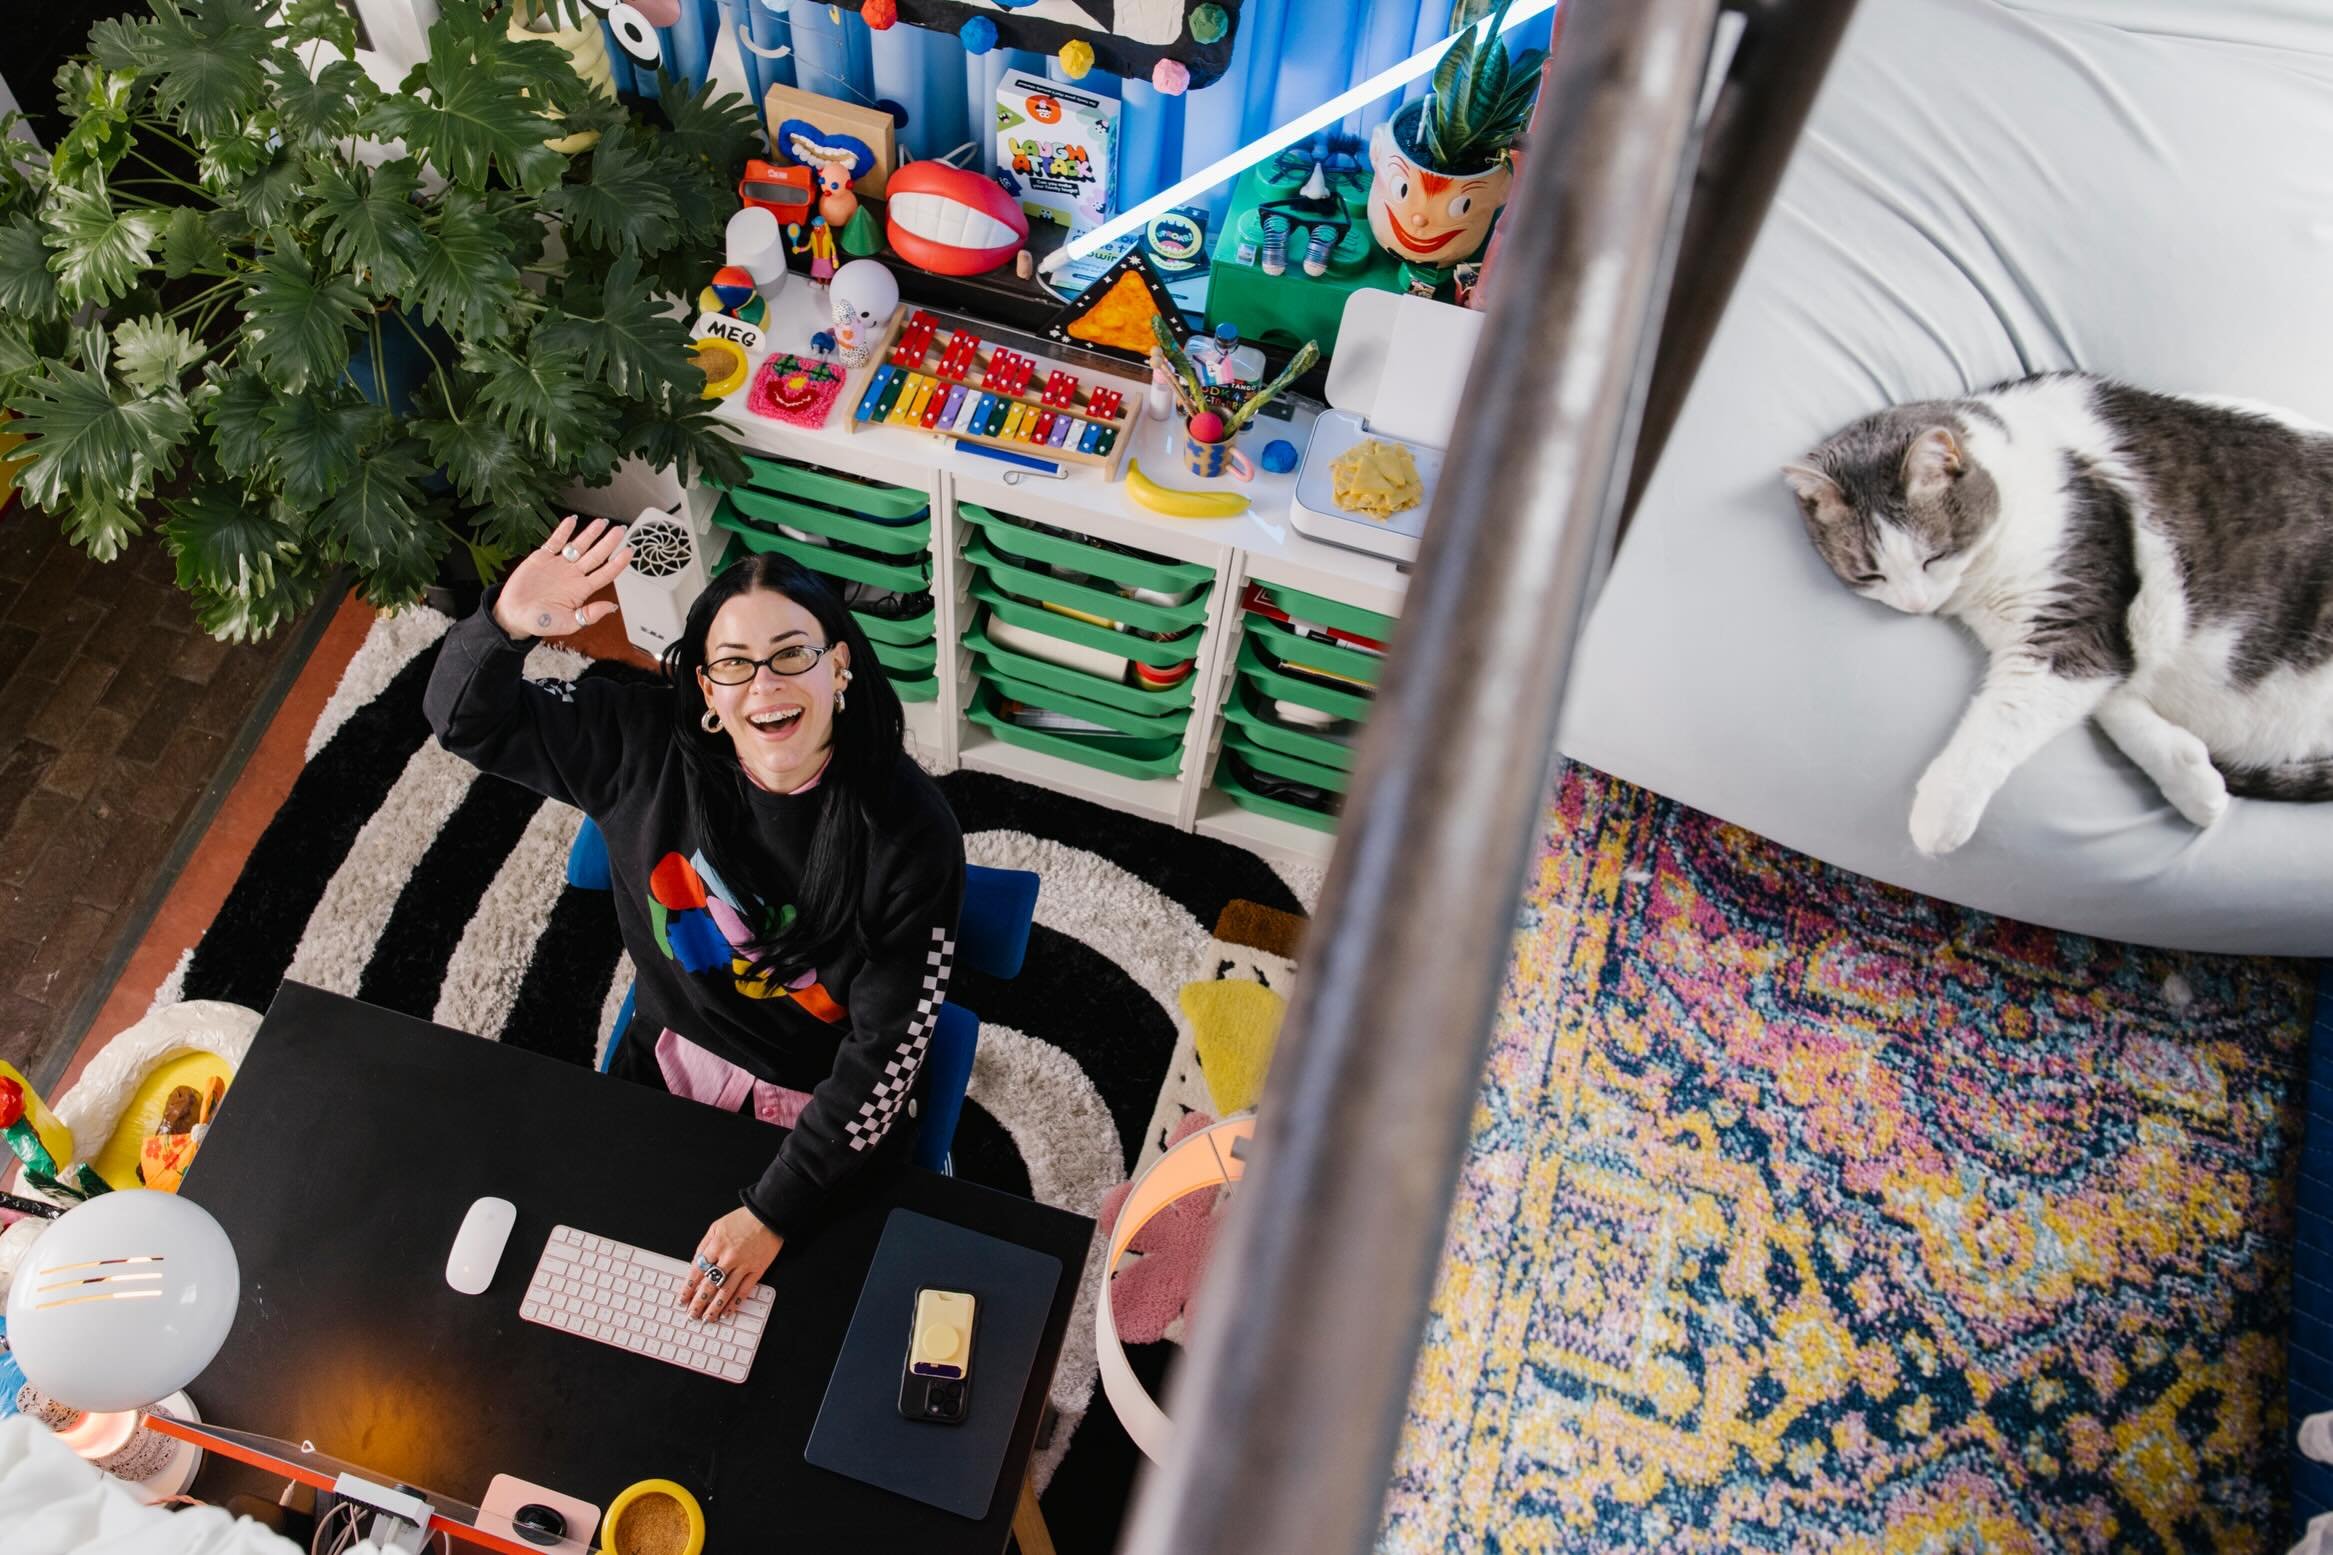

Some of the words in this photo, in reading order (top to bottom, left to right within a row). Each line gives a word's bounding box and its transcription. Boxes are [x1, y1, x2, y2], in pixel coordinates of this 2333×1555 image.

[1008, 137, 1087, 162] LAUGH
[1012, 154, 1095, 182] ATTACK
[707, 320, 756, 347] MEG
